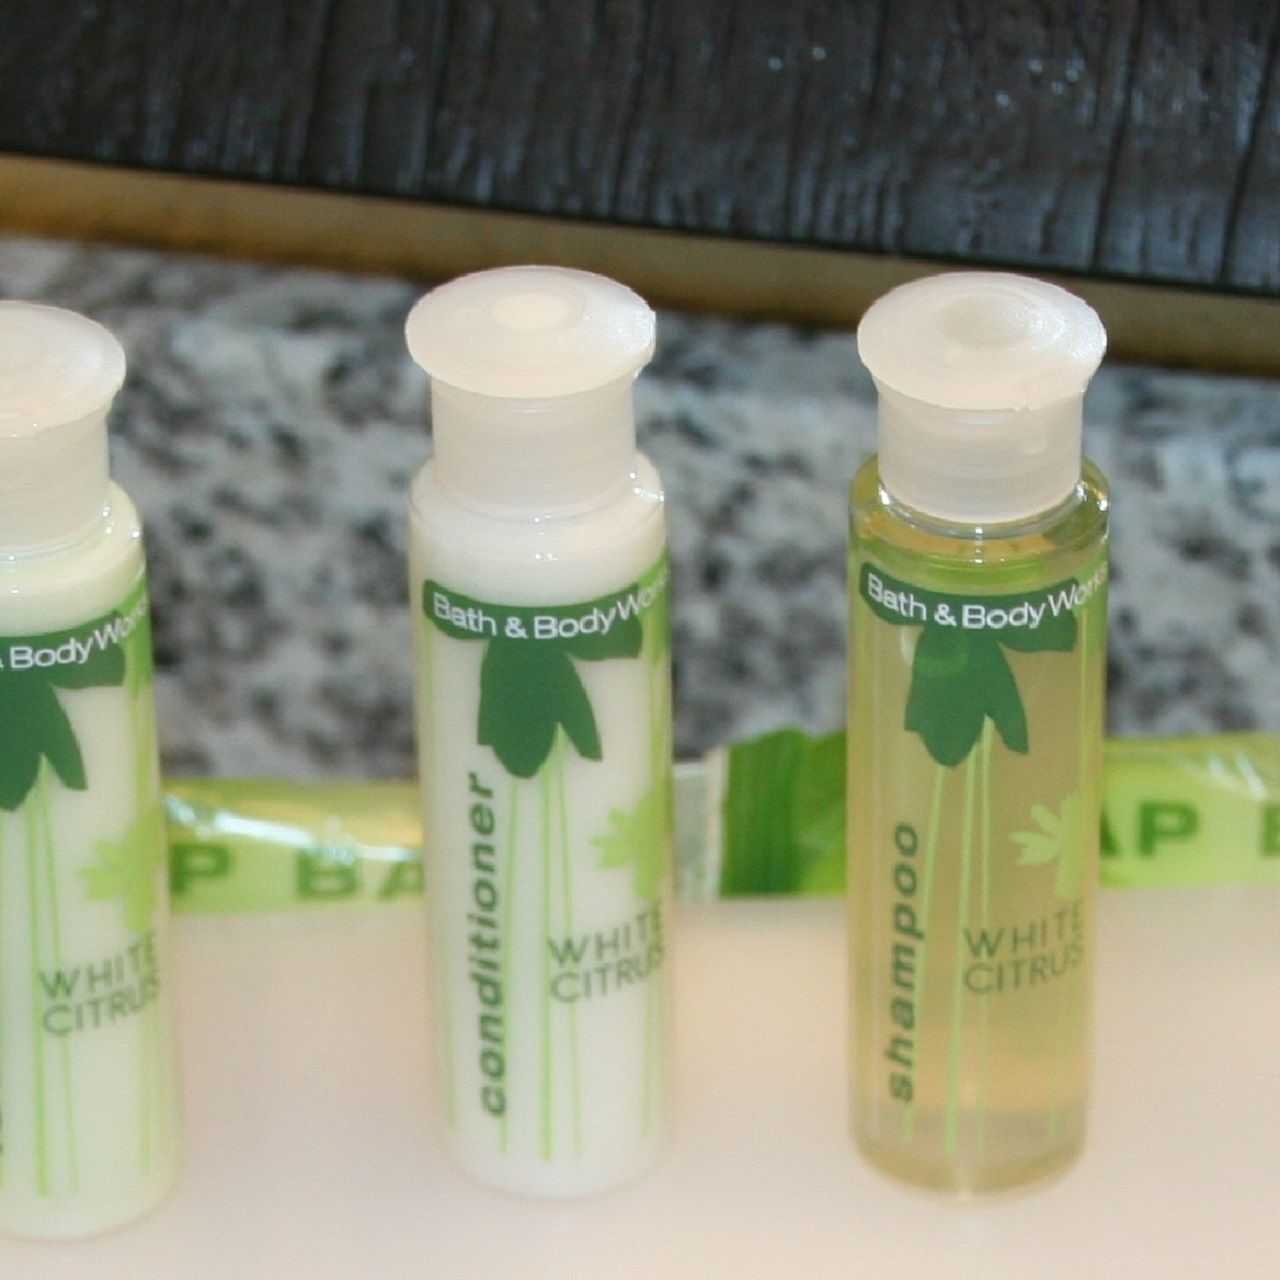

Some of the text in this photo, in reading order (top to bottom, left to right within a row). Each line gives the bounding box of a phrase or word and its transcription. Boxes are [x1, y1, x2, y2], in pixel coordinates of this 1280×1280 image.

[432, 591, 497, 637] Bath
[504, 616, 528, 640] &
[533, 606, 616, 640] Body
[867, 572, 927, 621] Bath
[933, 603, 957, 627] &
[961, 602, 1046, 629] Body
[9, 636, 93, 670] Body
[295, 847, 424, 899] BA
[468, 771, 508, 1118] conditioner
[963, 902, 1084, 958] WHITE
[883, 821, 925, 1104] shampoo
[963, 934, 1085, 995] CITRUS
